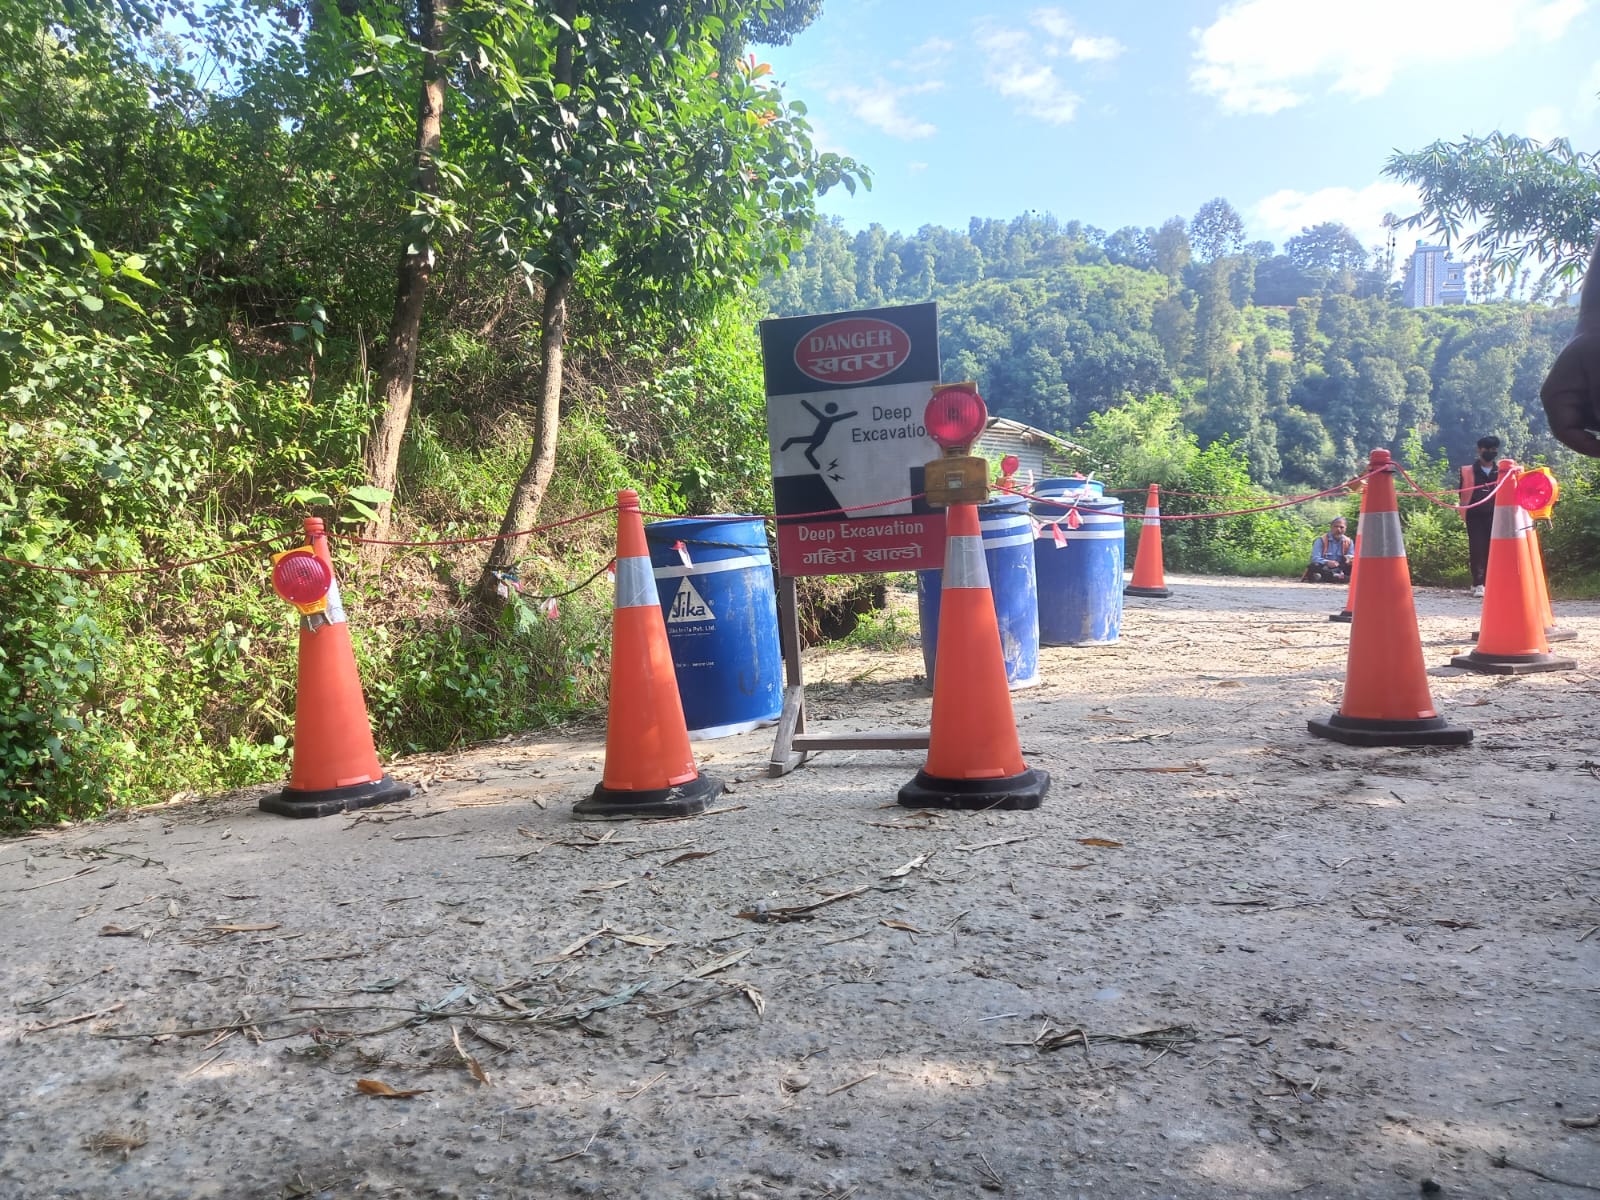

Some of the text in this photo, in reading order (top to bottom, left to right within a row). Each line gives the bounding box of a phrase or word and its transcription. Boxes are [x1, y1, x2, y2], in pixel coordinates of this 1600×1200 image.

[810, 329, 893, 353] DANGER
[808, 351, 897, 375] खतरा
[872, 406, 912, 422] Deep
[852, 423, 930, 443] Excavatio
[798, 521, 924, 543] Deep Excavation
[803, 543, 923, 565] गहिरो खाल्डो
[672, 591, 706, 618] Sika
